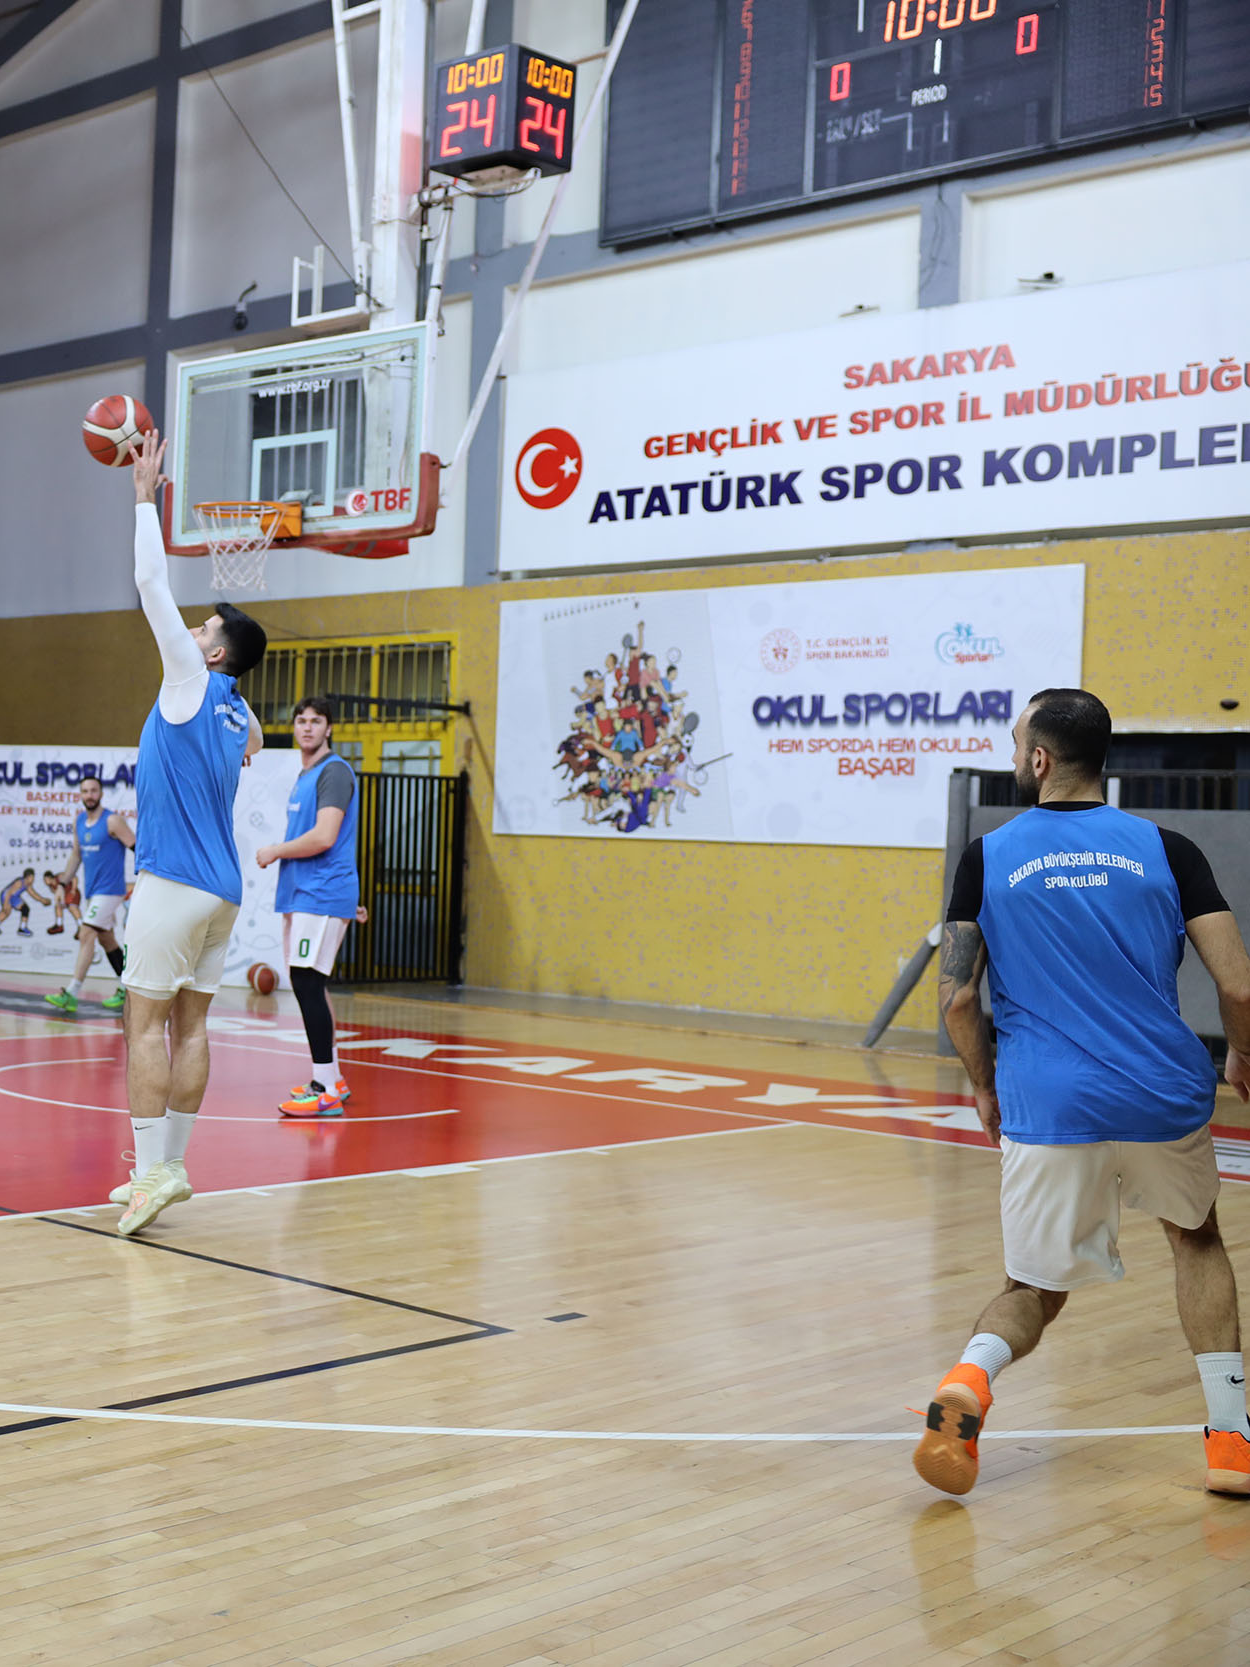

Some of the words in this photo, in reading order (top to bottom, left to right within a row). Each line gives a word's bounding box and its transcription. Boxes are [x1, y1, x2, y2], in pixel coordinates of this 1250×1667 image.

[1016, 14, 1039, 55] 0
[447, 53, 504, 94] 10:00
[526, 57, 573, 98] 10:00
[830, 62, 850, 101] 0
[911, 84, 947, 107] PERIOD
[440, 94, 496, 157] 24
[520, 96, 566, 159] 24
[844, 344, 1015, 389] SAKARYA
[258, 379, 331, 398] www.tbf.org.tr
[644, 418, 782, 458] GENÇLİK
[794, 415, 838, 440] VE
[849, 401, 945, 434] SPOR
[957, 392, 991, 422] İL
[589, 472, 803, 524] ATATÜRK
[820, 455, 962, 500] SPOR
[983, 423, 1250, 487] KOMPLE
[370, 488, 411, 512] TBF
[752, 695, 838, 726] OKUL
[843, 690, 1013, 726] SPORLARI
[769, 738, 803, 753] HEM
[807, 738, 874, 753] SPORDA
[878, 737, 916, 752] HEM
[919, 737, 993, 752] OKULDA
[838, 758, 915, 779] BAŞARI
[1008, 858, 1044, 888] SAKARYA
[1043, 850, 1096, 869] BÜYÜKŞEHİR
[1095, 851, 1144, 878] BELEDİYESİ
[1044, 876, 1070, 889] SPOR
[1070, 872, 1108, 888] KULÜBÜ
[88, 905, 98, 918] 5
[299, 938, 310, 958] 0
